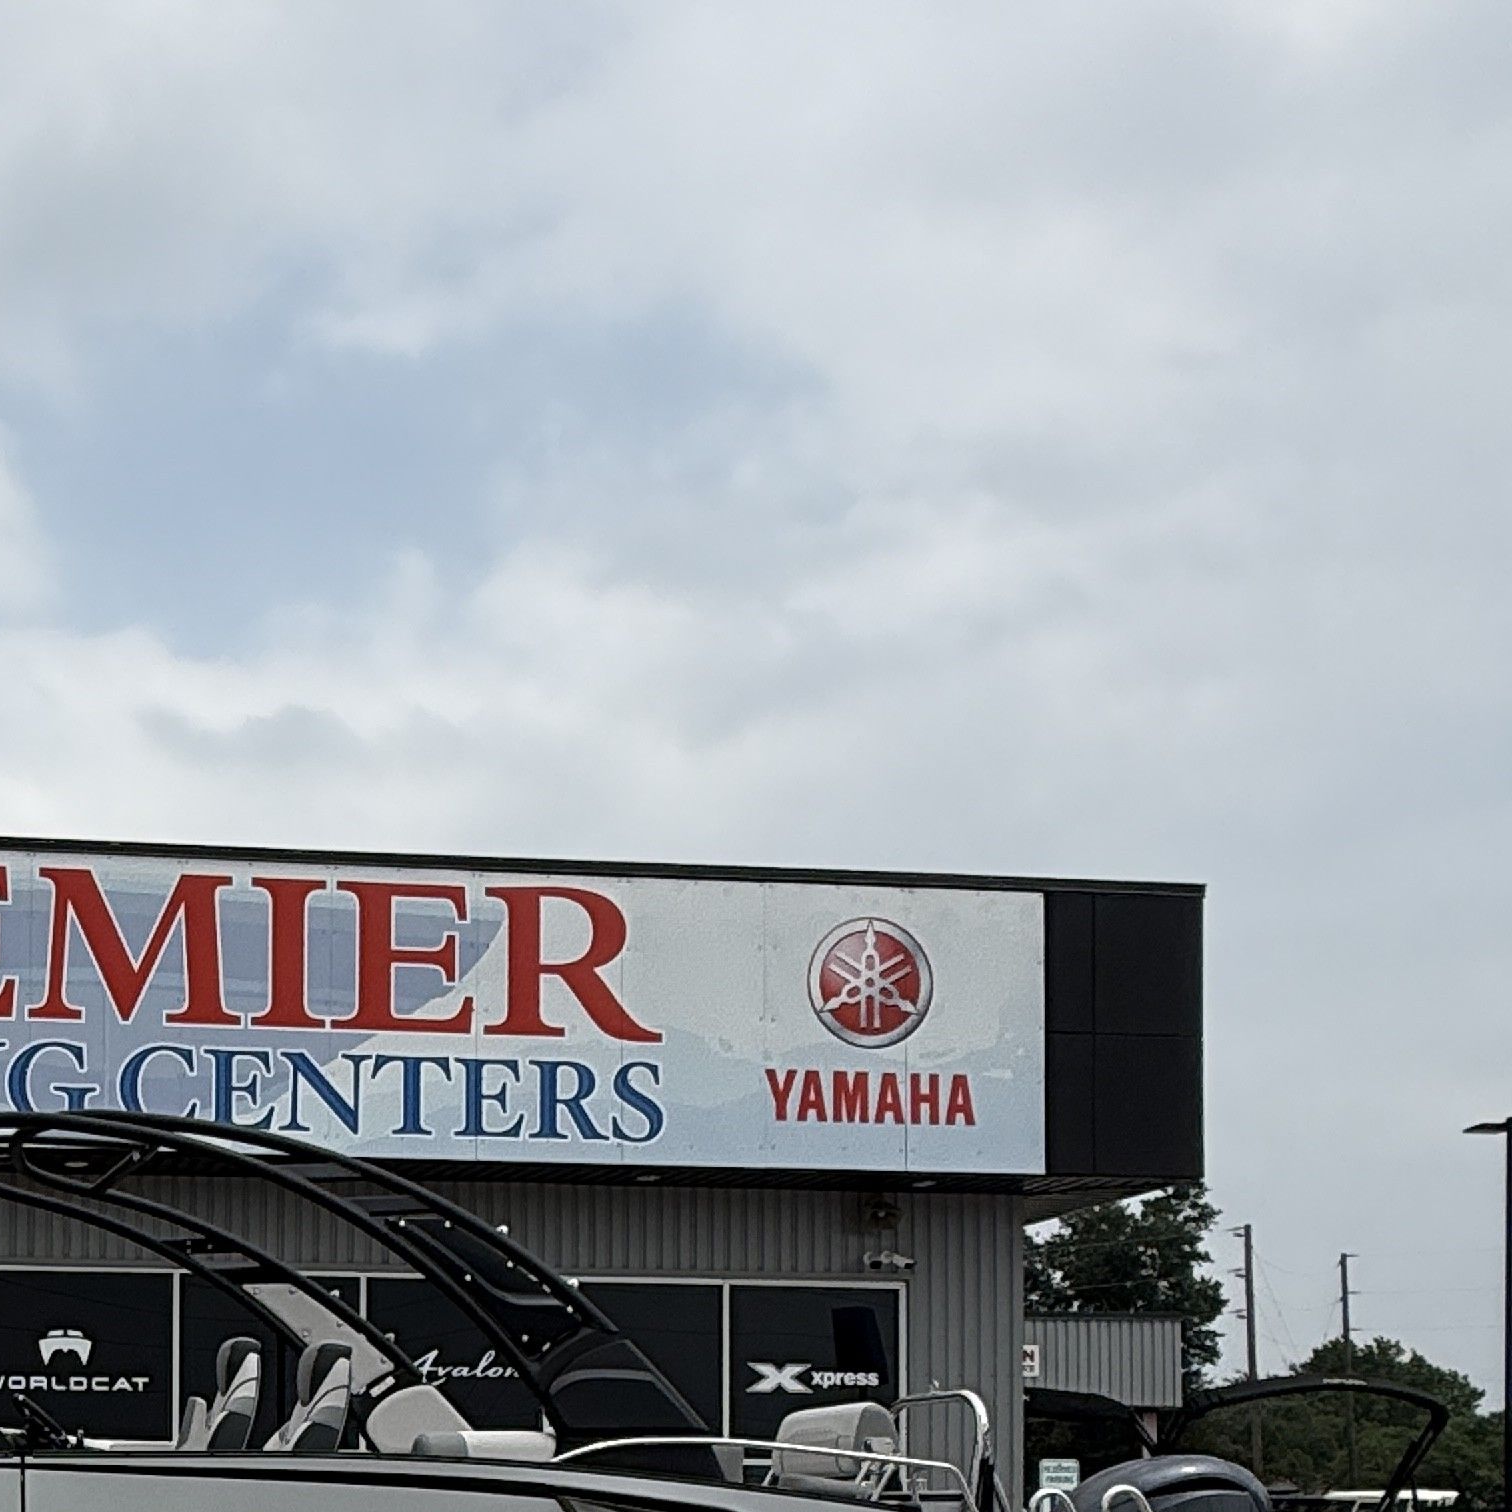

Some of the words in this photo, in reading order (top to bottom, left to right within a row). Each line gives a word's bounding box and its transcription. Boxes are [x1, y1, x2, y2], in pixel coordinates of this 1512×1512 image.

[117, 1042, 664, 1144] CENTERS
[764, 1068, 977, 1126] YAMAHA
[412, 1348, 520, 1387] Avalon
[810, 1370, 879, 1390] xpress
